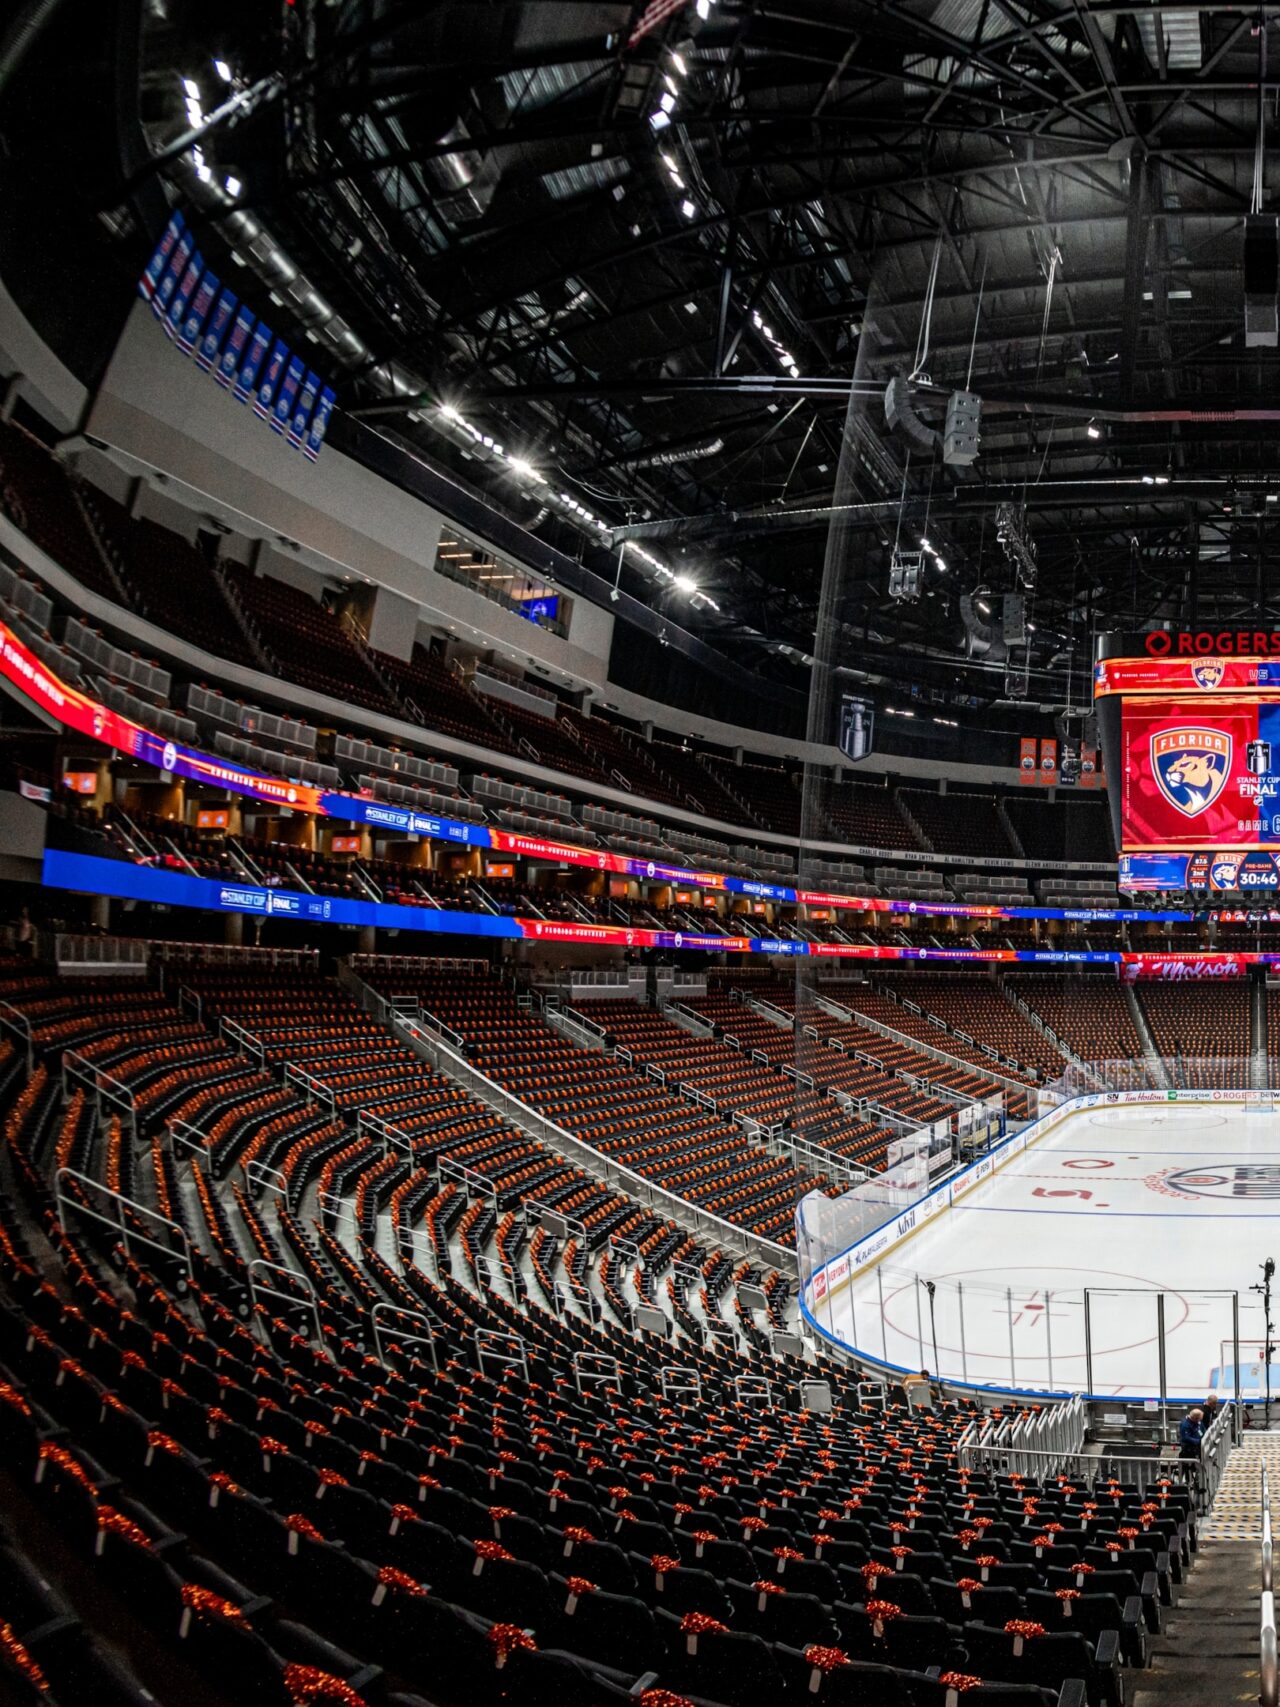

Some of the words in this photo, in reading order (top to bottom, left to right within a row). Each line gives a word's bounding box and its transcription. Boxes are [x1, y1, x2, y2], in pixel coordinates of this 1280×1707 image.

[1249, 669, 1268, 680] VS
[1160, 734, 1222, 750] FLORIDA
[1236, 776, 1265, 784] STANLEY
[1266, 776, 1280, 784] CUP
[1239, 784, 1277, 795] FINAL
[372, 810, 396, 823] STANLEY
[415, 819, 432, 831] FINAL
[1237, 819, 1269, 832] GAME
[1240, 873, 1278, 885] 30:46
[227, 891, 253, 904] STANLEY
[253, 896, 266, 906] CUP
[273, 898, 291, 910] FINAL
[1124, 1093, 1137, 1102] Tim
[1137, 1092, 1165, 1102] Hortons
[897, 1210, 916, 1238] Advil
